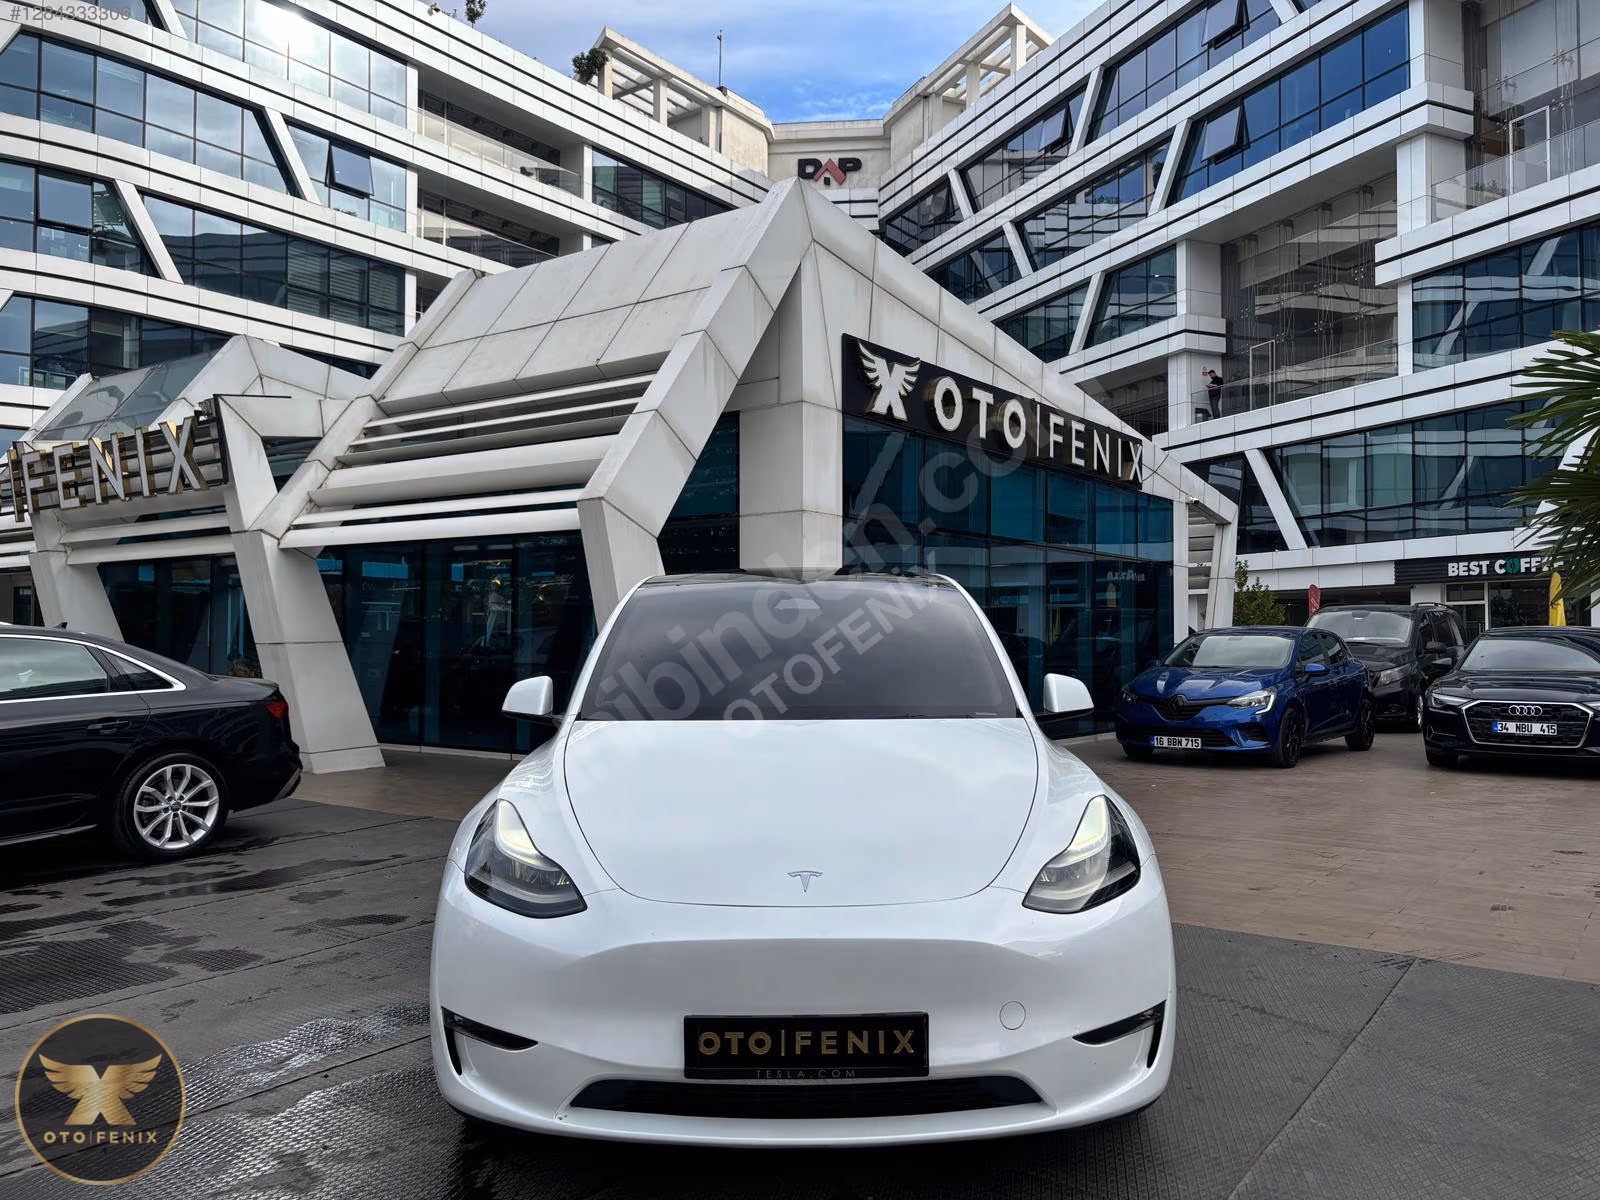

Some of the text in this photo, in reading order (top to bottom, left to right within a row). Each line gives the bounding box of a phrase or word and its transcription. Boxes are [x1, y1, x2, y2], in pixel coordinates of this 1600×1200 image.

[797, 158, 863, 186] DAP
[932, 375, 1143, 483] OTO FENIX
[21, 415, 209, 515] FENIX
[1448, 560, 1490, 577] BEST
[1498, 722, 1556, 735] 34 NBU 415
[1155, 736, 1164, 746] 16
[1184, 738, 1200, 748] 715
[698, 1029, 915, 1055] OTO FENIX
[756, 1069, 856, 1079] TESLA.COM
